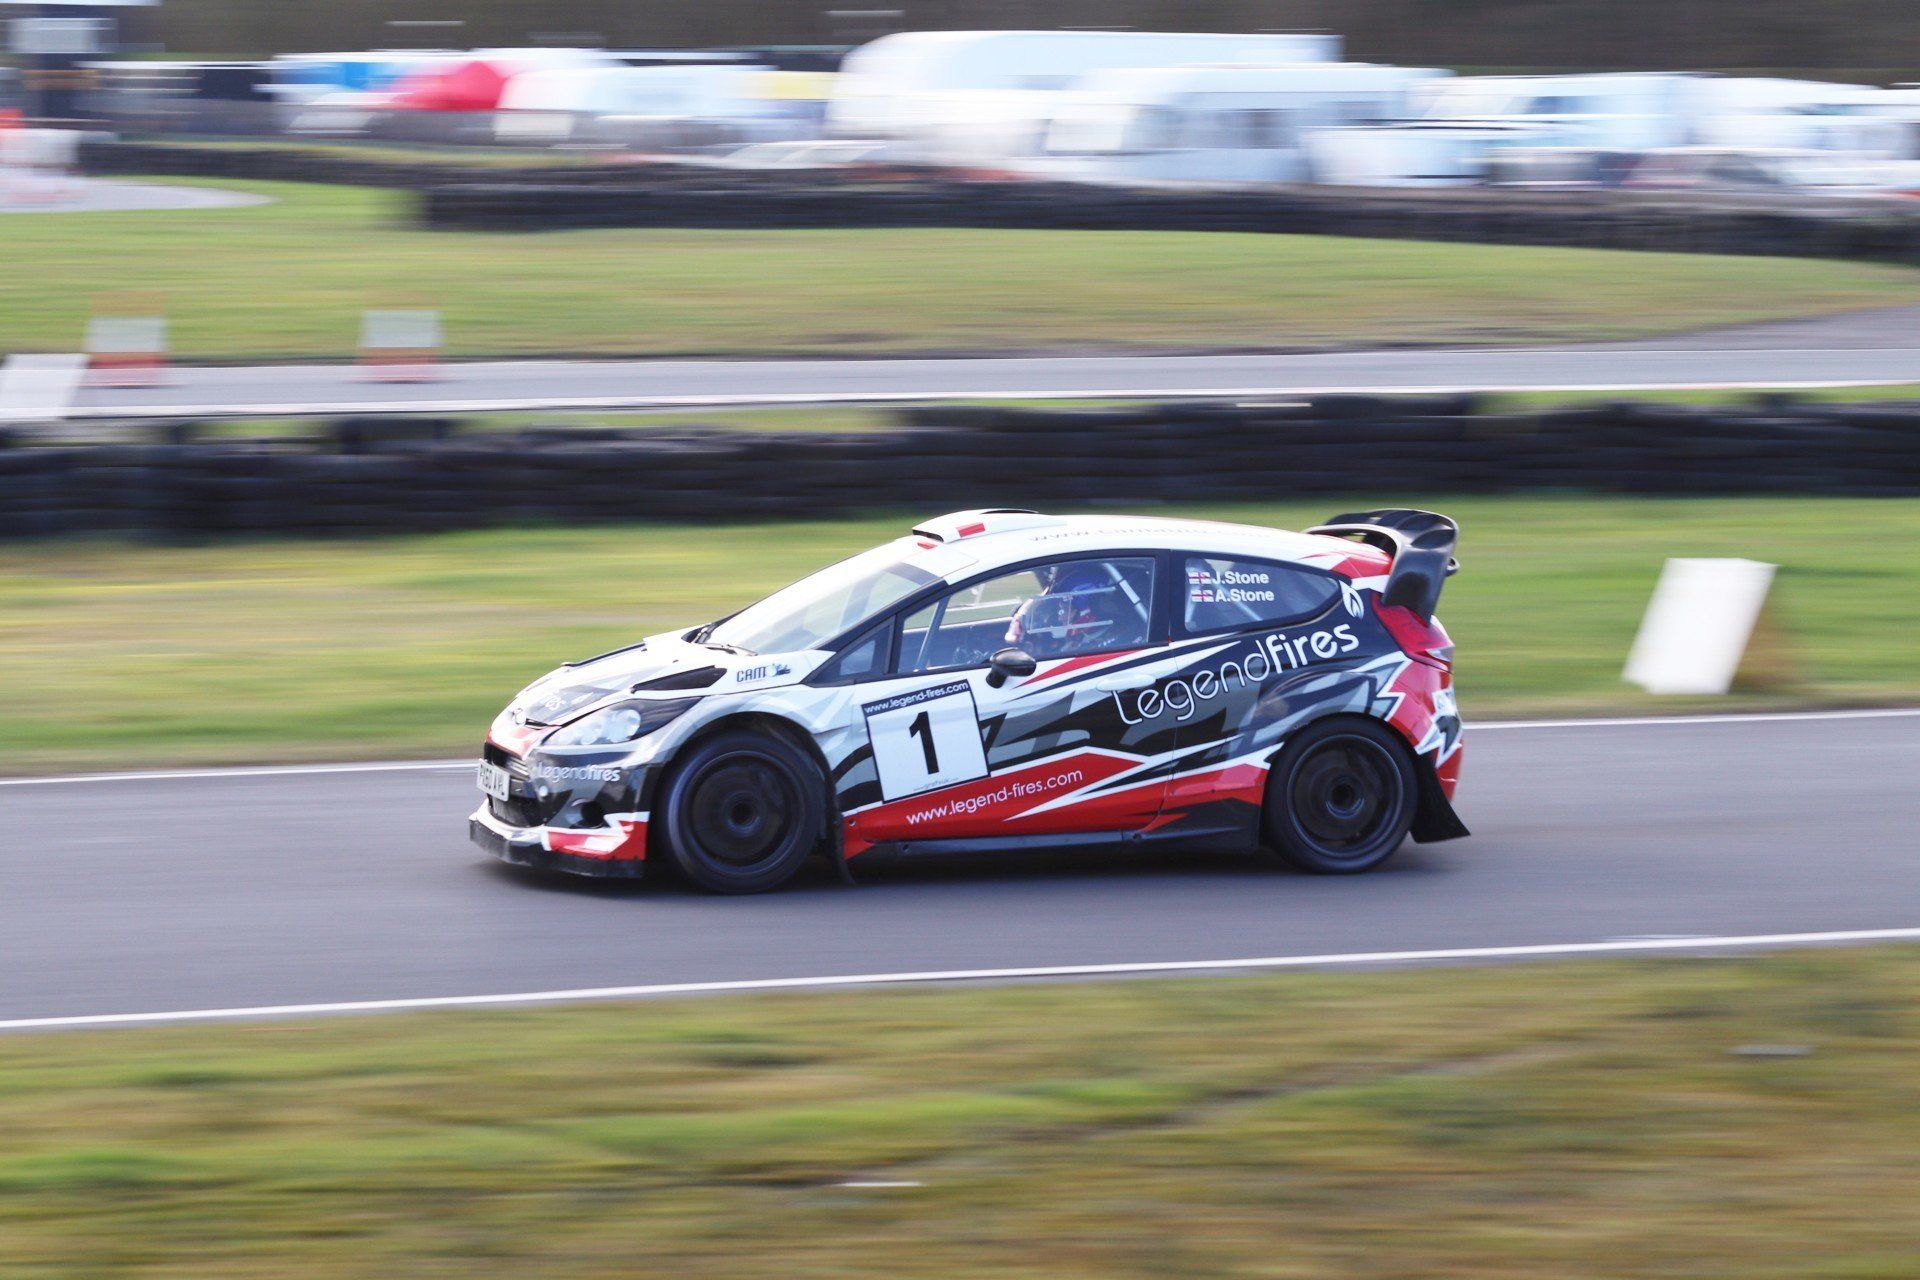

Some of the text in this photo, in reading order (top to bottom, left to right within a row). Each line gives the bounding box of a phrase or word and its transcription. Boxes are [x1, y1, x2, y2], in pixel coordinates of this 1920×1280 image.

[1212, 571, 1270, 585] J.Stone
[1215, 589, 1275, 602] A.Stone
[864, 681, 969, 714] www.legend-fires.com
[909, 711, 939, 775] 1
[906, 768, 1083, 825] www.legend-fires.com
